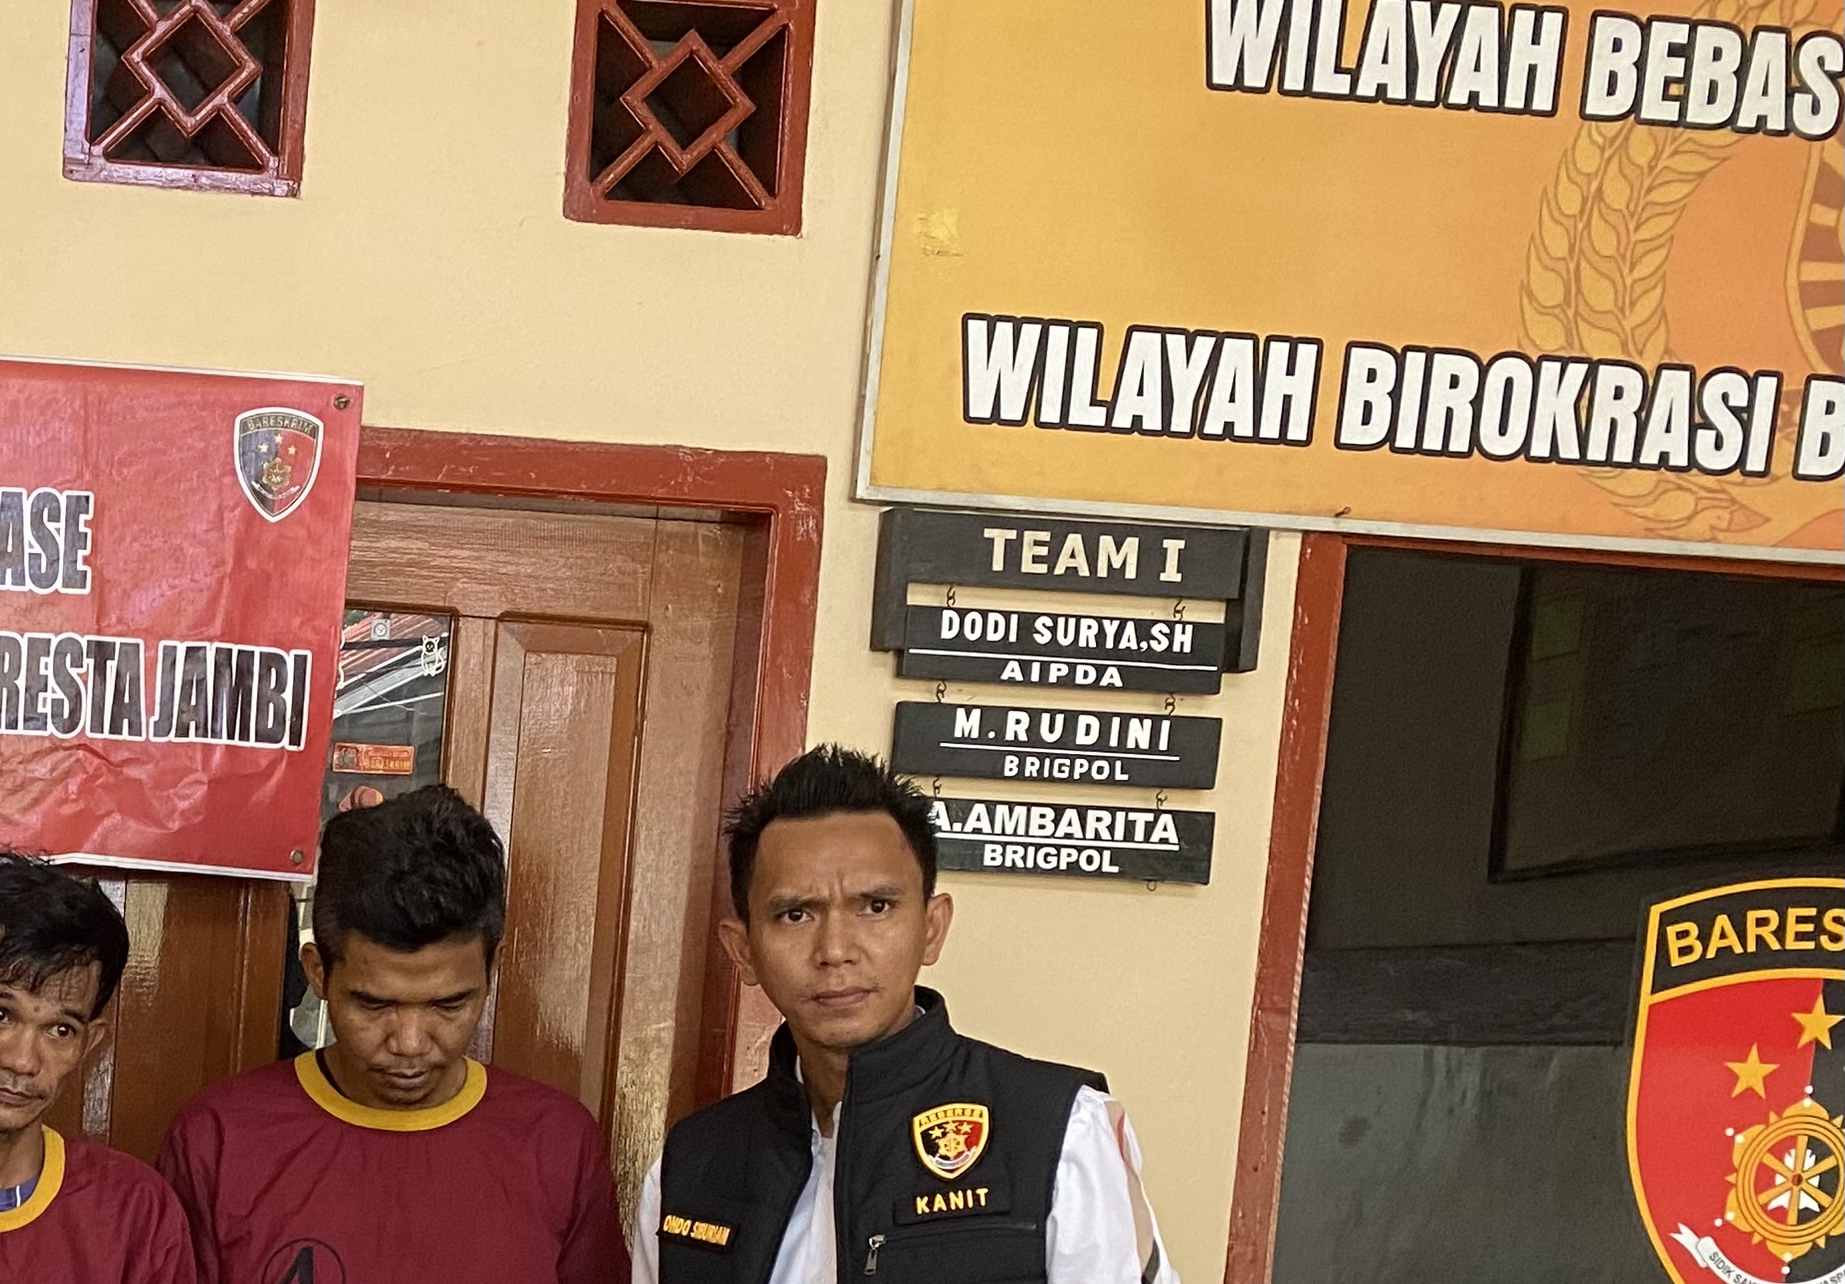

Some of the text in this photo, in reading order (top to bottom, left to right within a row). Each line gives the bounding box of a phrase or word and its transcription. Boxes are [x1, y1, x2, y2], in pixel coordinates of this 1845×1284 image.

[1206, 0, 1844, 141] WILAYAH BEBAS
[962, 314, 1322, 446] WILAYAH
[1335, 340, 1783, 478] BIROKRASI
[983, 528, 1186, 583] TEAM I
[940, 609, 1193, 654] DODI SURYA,SH
[149, 639, 313, 751] JAMBI
[1000, 660, 1123, 687] AIPDA
[1004, 755, 1130, 781] BRIGPOL
[983, 844, 1120, 873] BRIGPOL
[1666, 907, 1844, 968] BARES
[916, 1187, 989, 1215] KANIT
[1709, 1251, 1735, 1279] SIDIK
